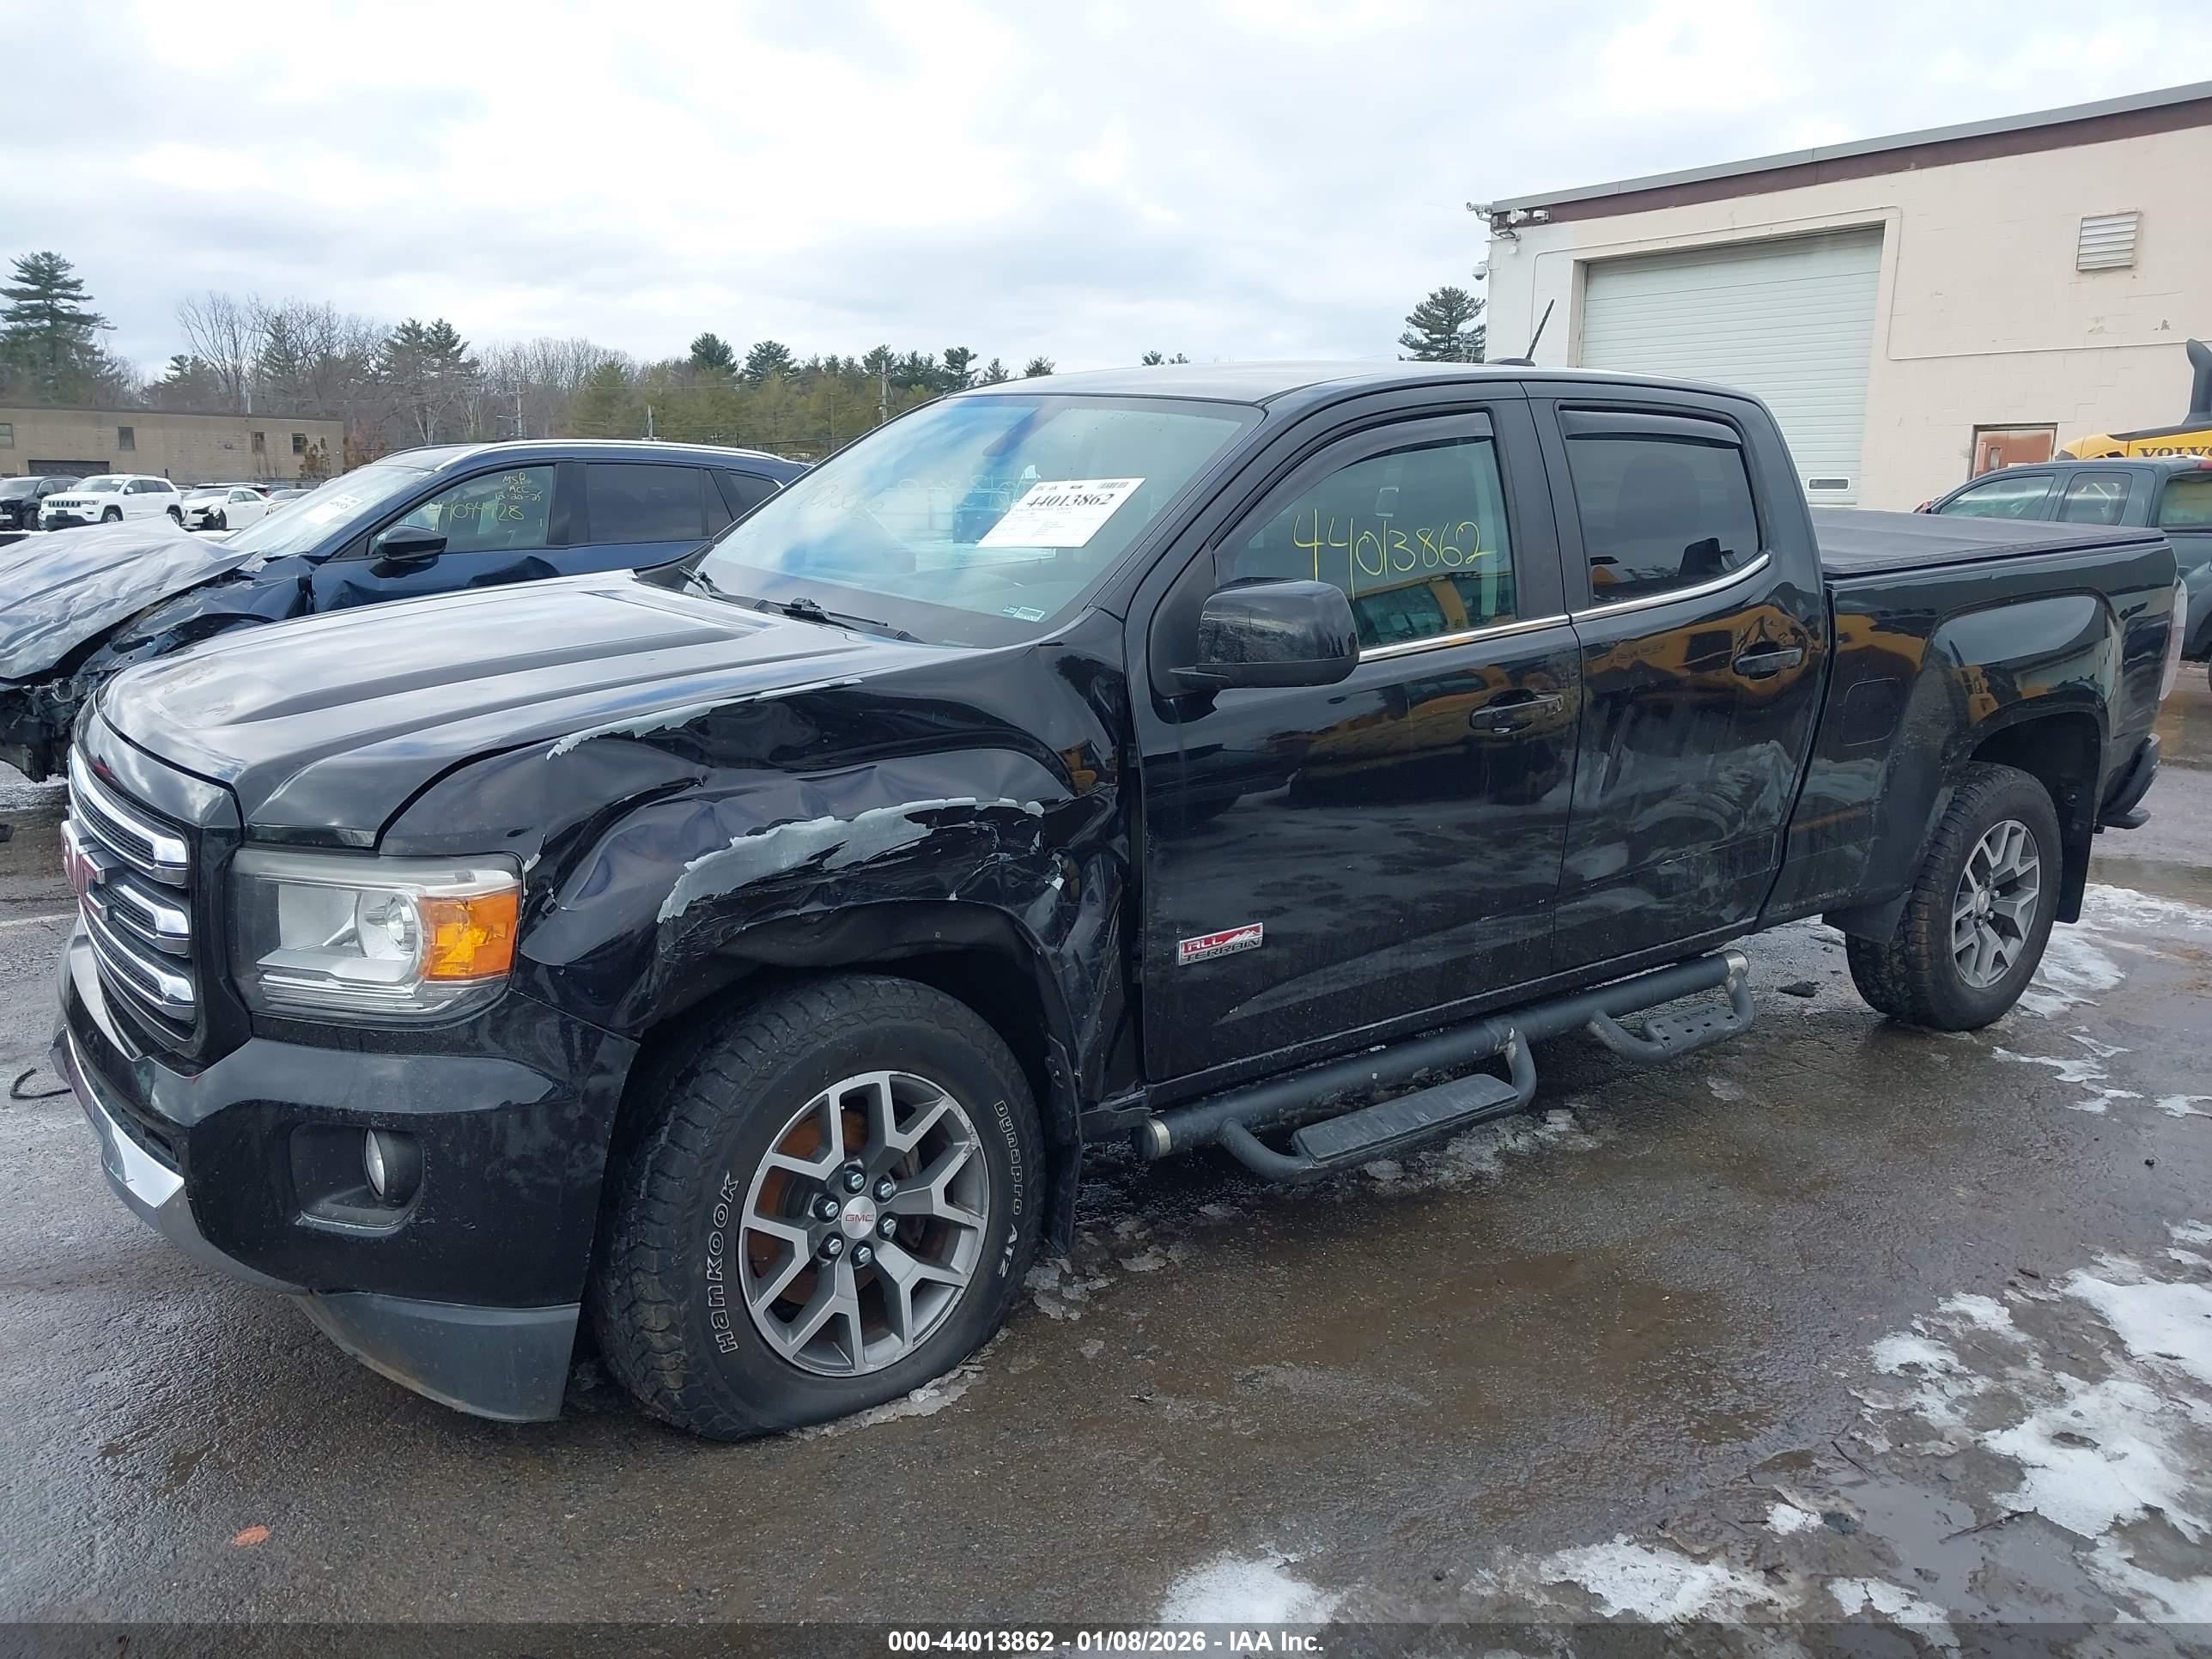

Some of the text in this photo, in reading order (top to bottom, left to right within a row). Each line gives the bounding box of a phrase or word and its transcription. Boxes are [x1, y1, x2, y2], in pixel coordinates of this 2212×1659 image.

[2138, 446, 2212, 458] VOLV
[1026, 493, 1115, 507] 44013862
[1292, 507, 1498, 602] 44013862
[1183, 938, 1261, 962] TERRAIN
[1188, 937, 1223, 951] ALL
[845, 1213, 874, 1223] GMC
